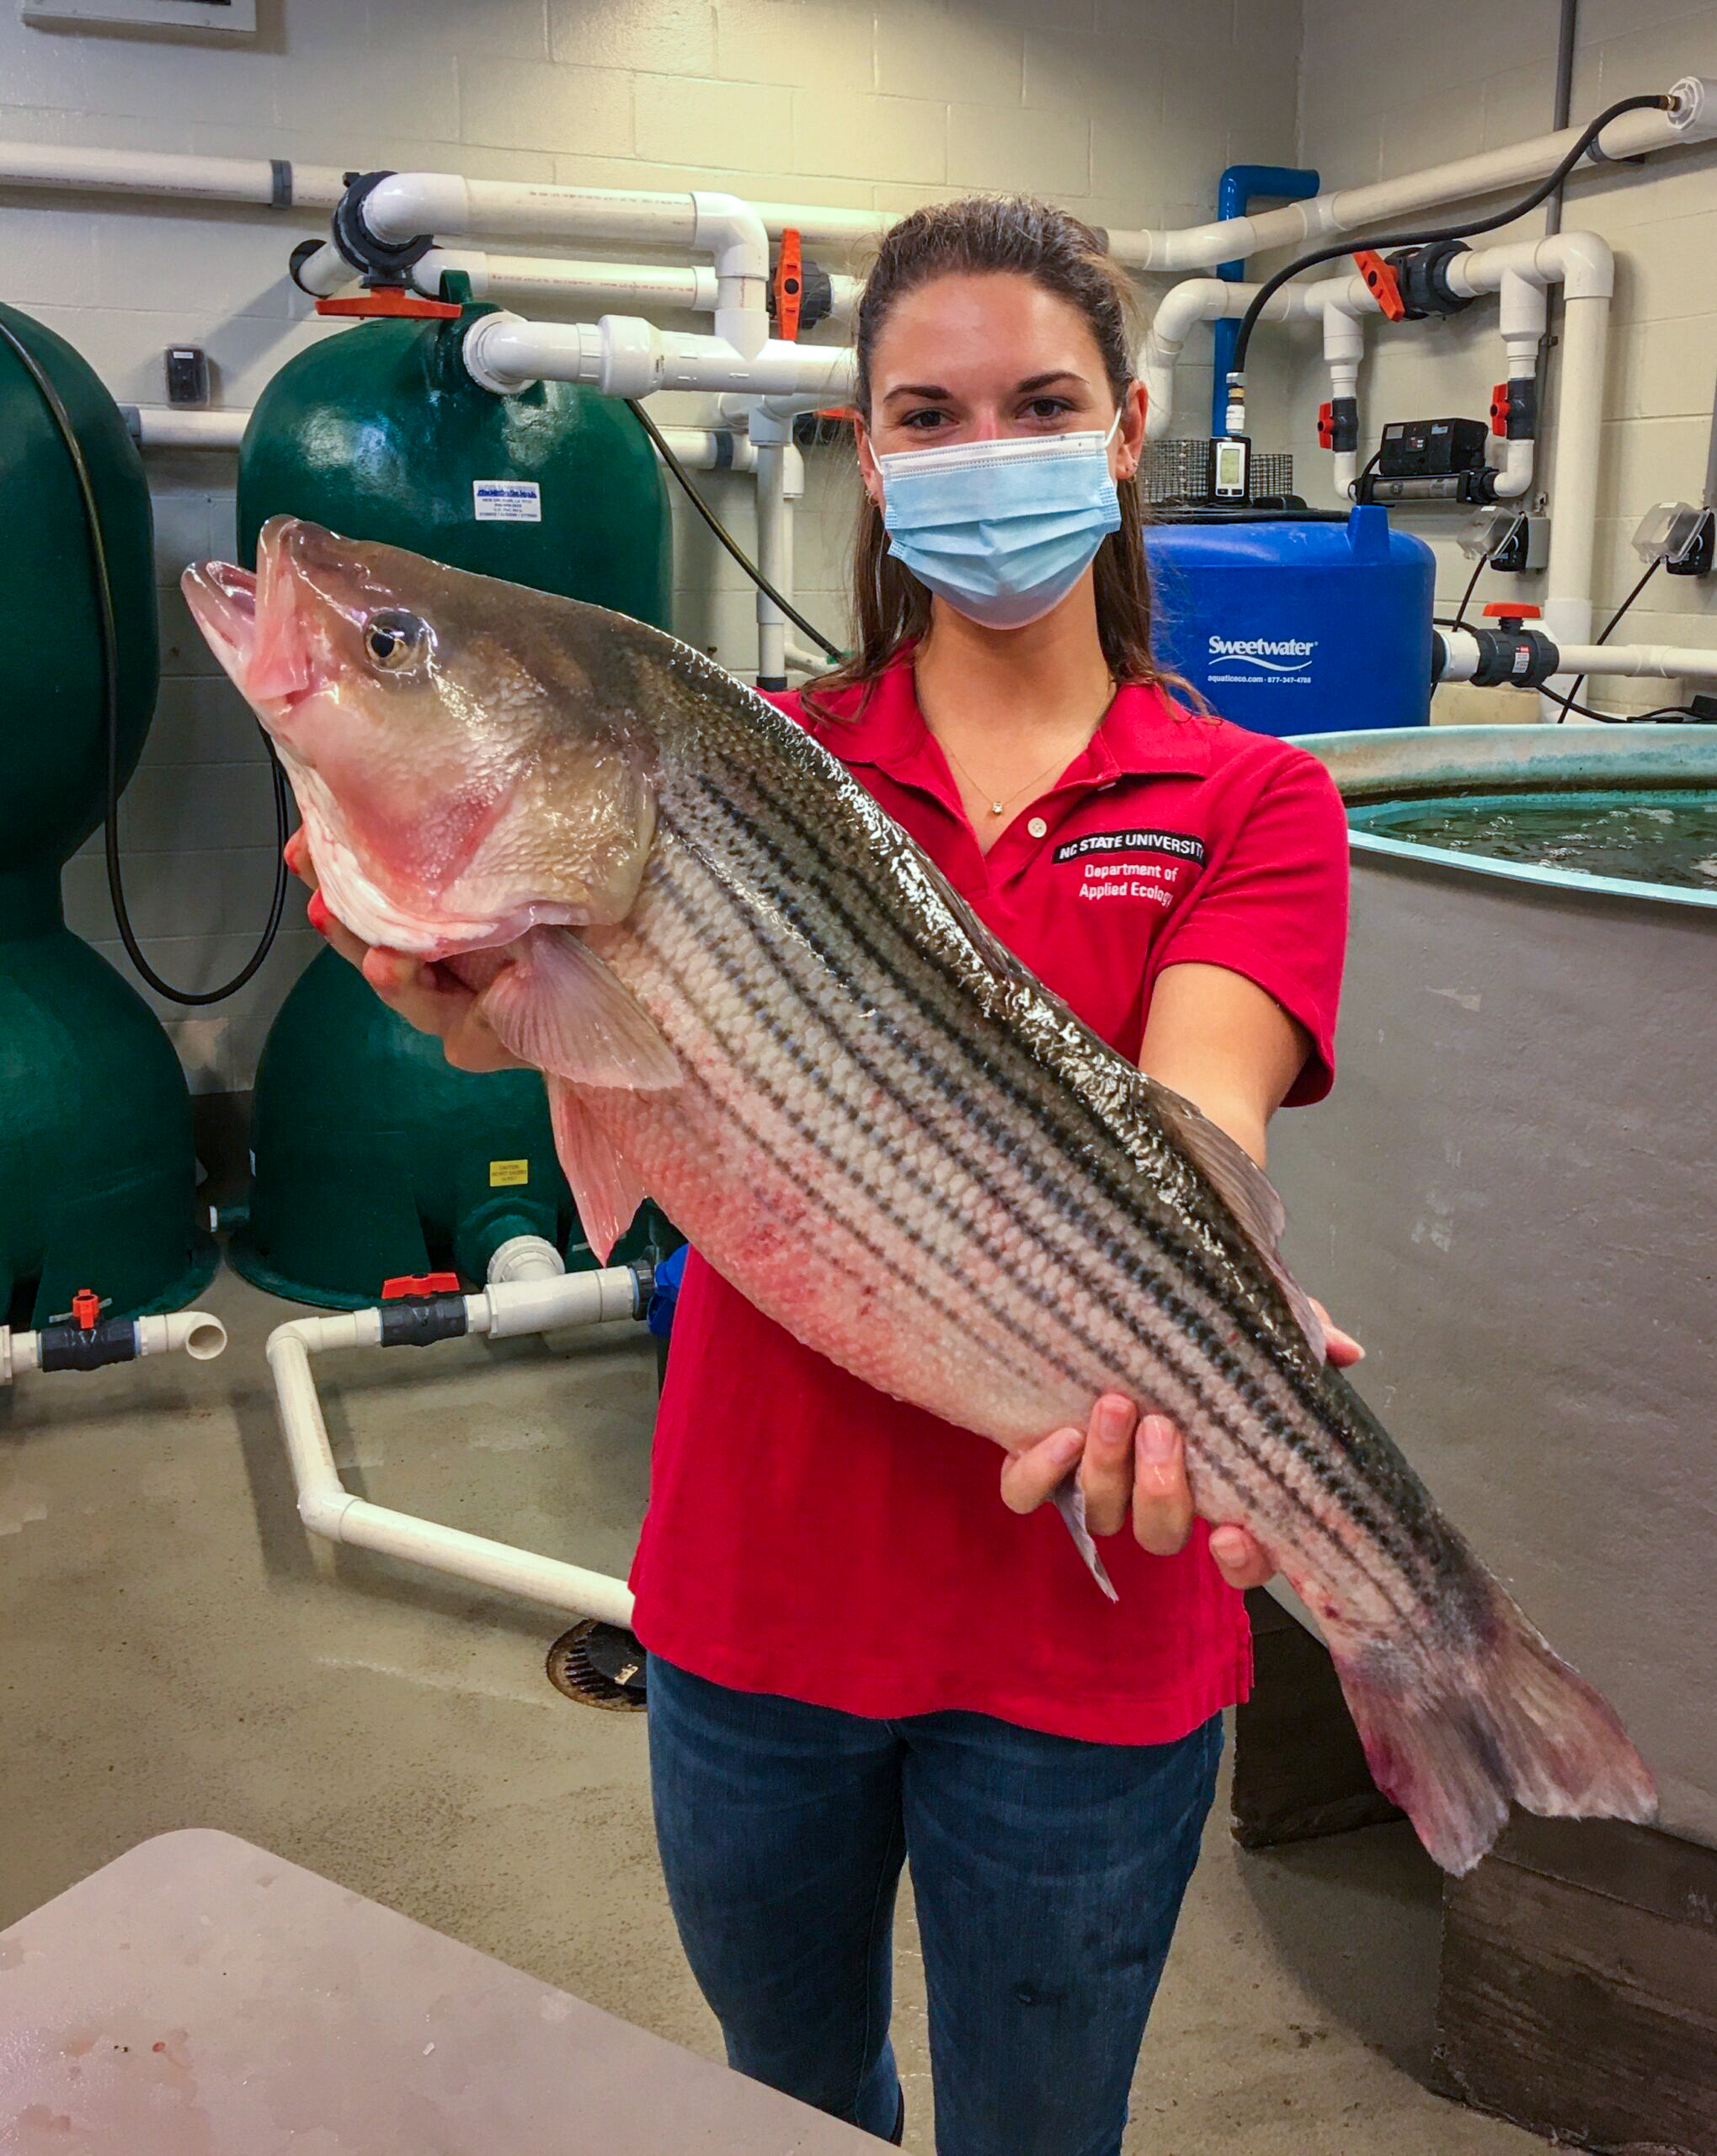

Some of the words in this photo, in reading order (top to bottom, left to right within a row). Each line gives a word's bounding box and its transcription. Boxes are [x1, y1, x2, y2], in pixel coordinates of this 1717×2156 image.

[1208, 635, 1314, 656] Sweetwater
[1207, 675, 1264, 684] aquaticeco.com
[1058, 843, 1078, 860] NC
[1079, 835, 1123, 852] STATE
[1084, 863, 1162, 879] Department
[1164, 867, 1179, 882] of
[1078, 882, 1128, 901] Applied
[1130, 882, 1174, 908] Ecology
